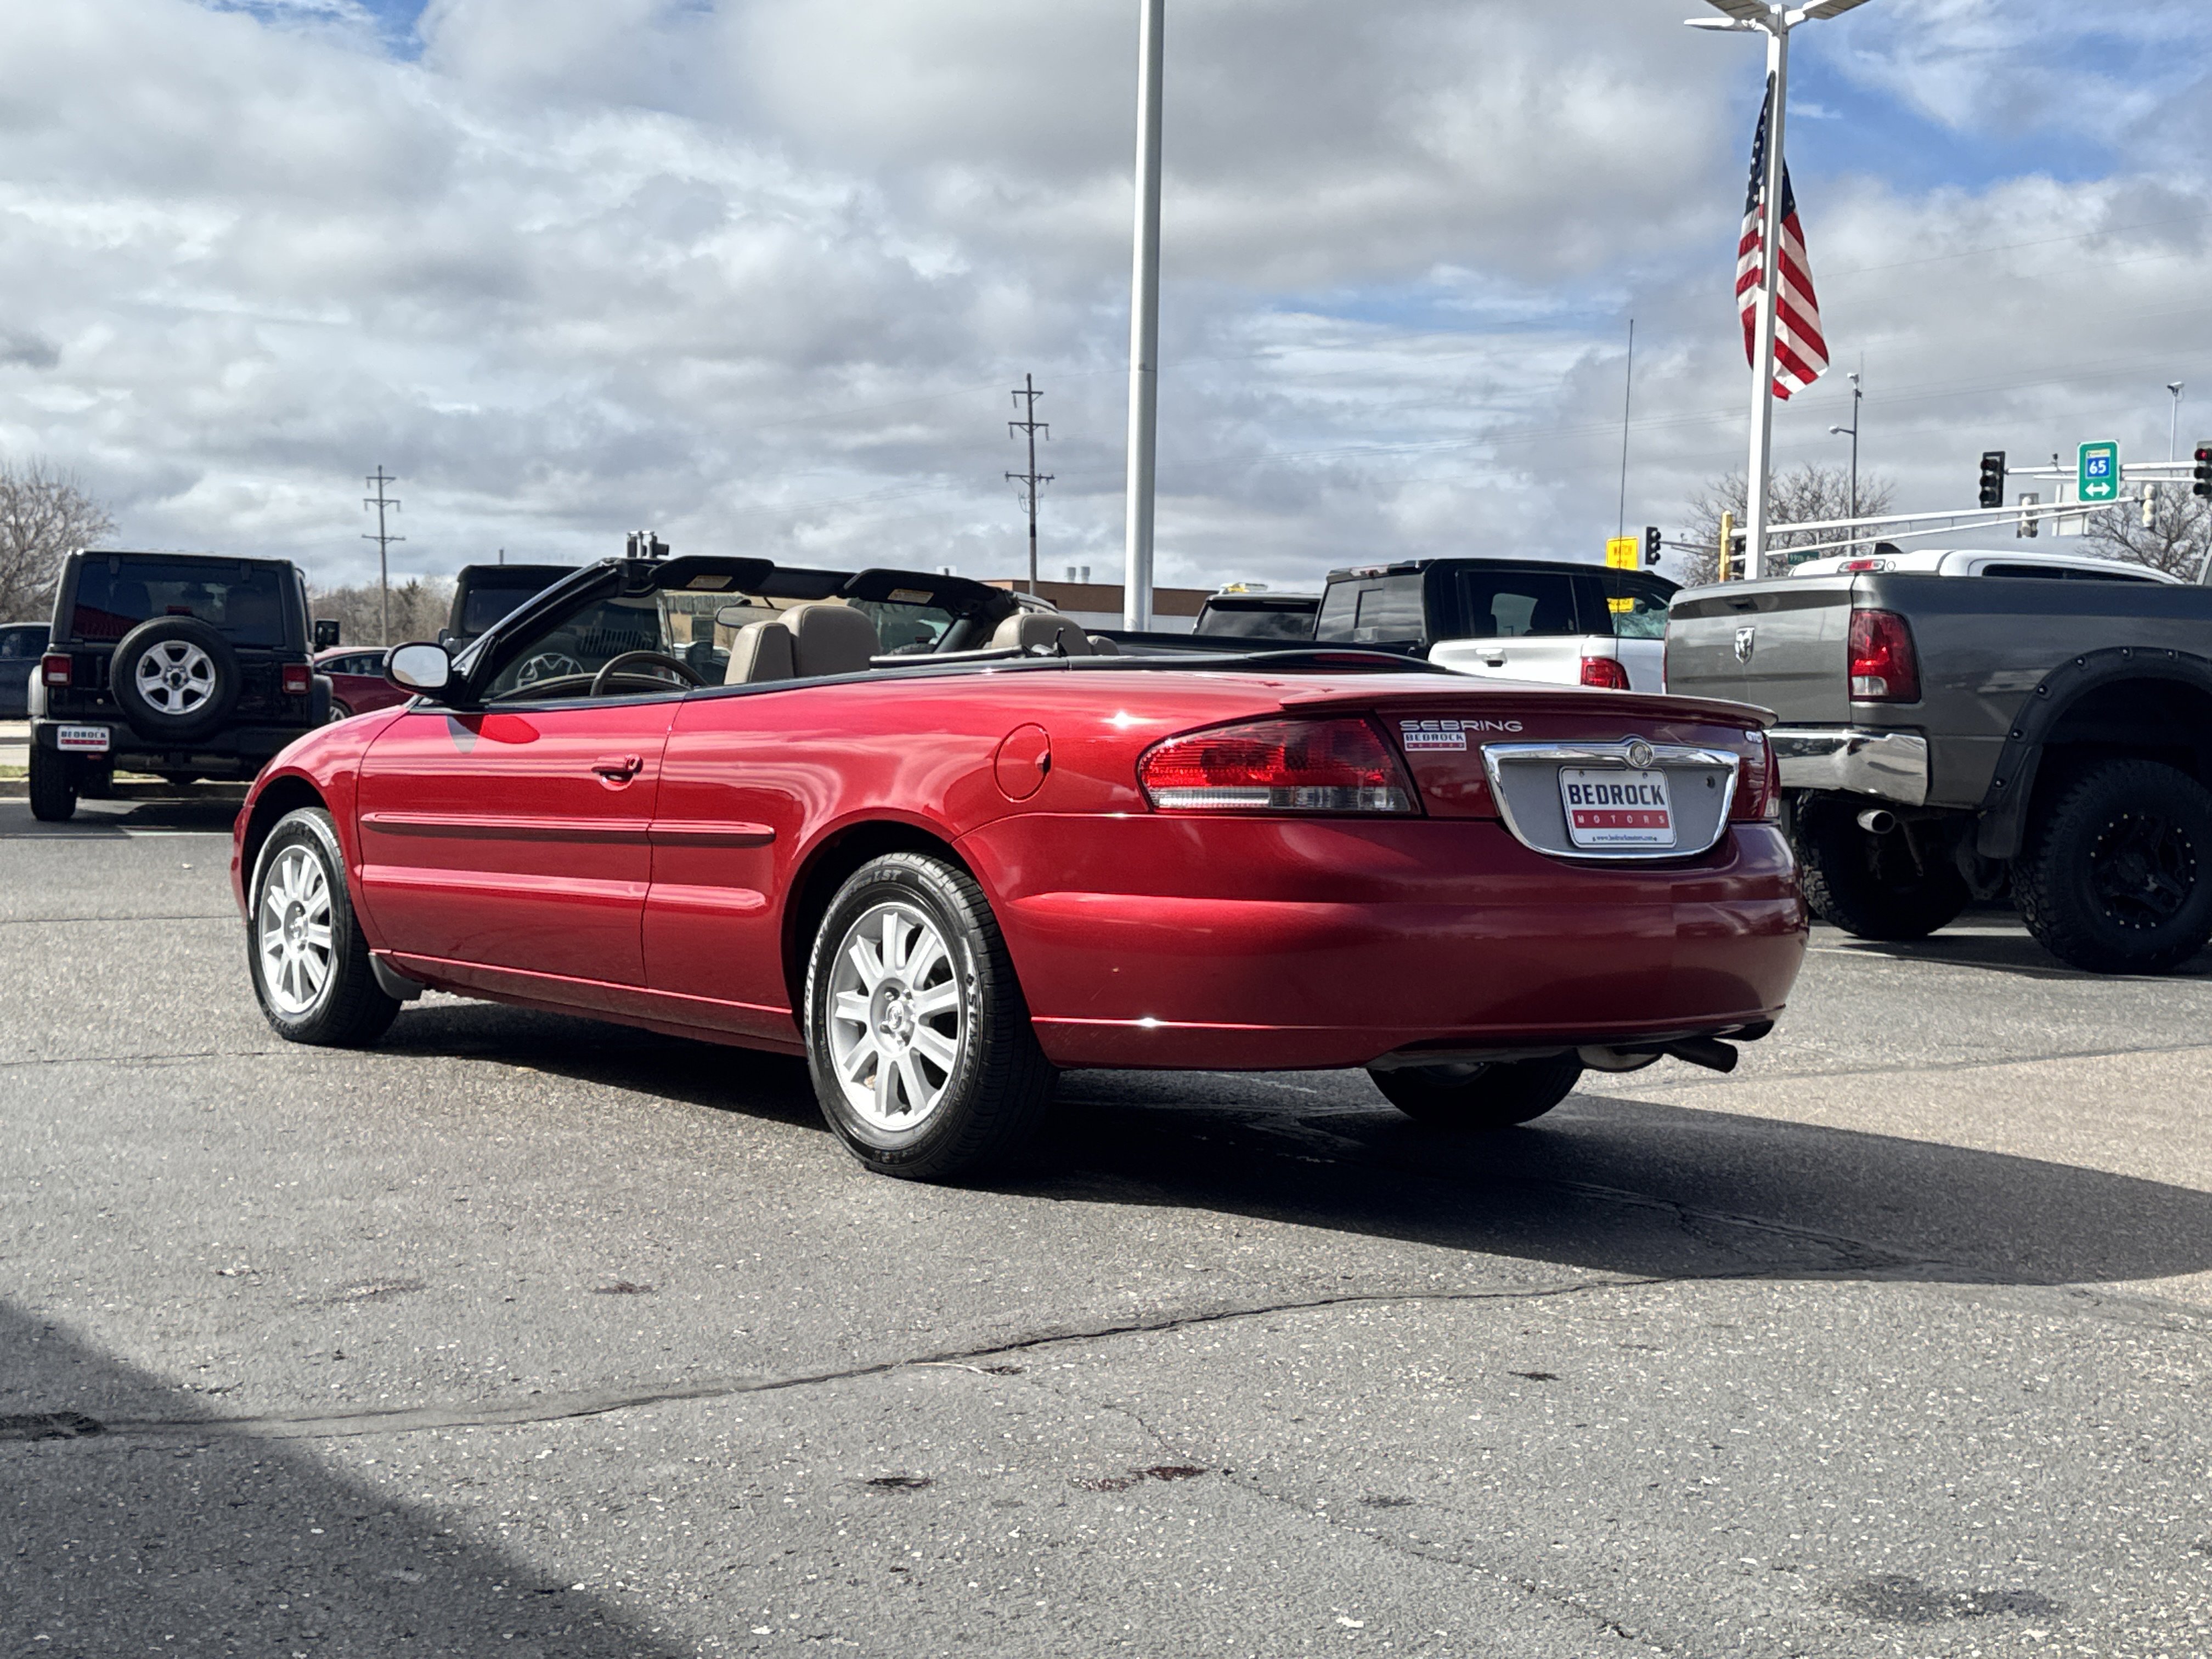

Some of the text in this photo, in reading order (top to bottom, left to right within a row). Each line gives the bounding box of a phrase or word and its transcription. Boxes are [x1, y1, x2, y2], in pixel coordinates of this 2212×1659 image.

[2089, 460, 2107, 475] 65
[1400, 720, 1523, 732] SEBRING
[1567, 784, 1665, 805] BEDROCK
[1577, 815, 1665, 824] MOTORS
